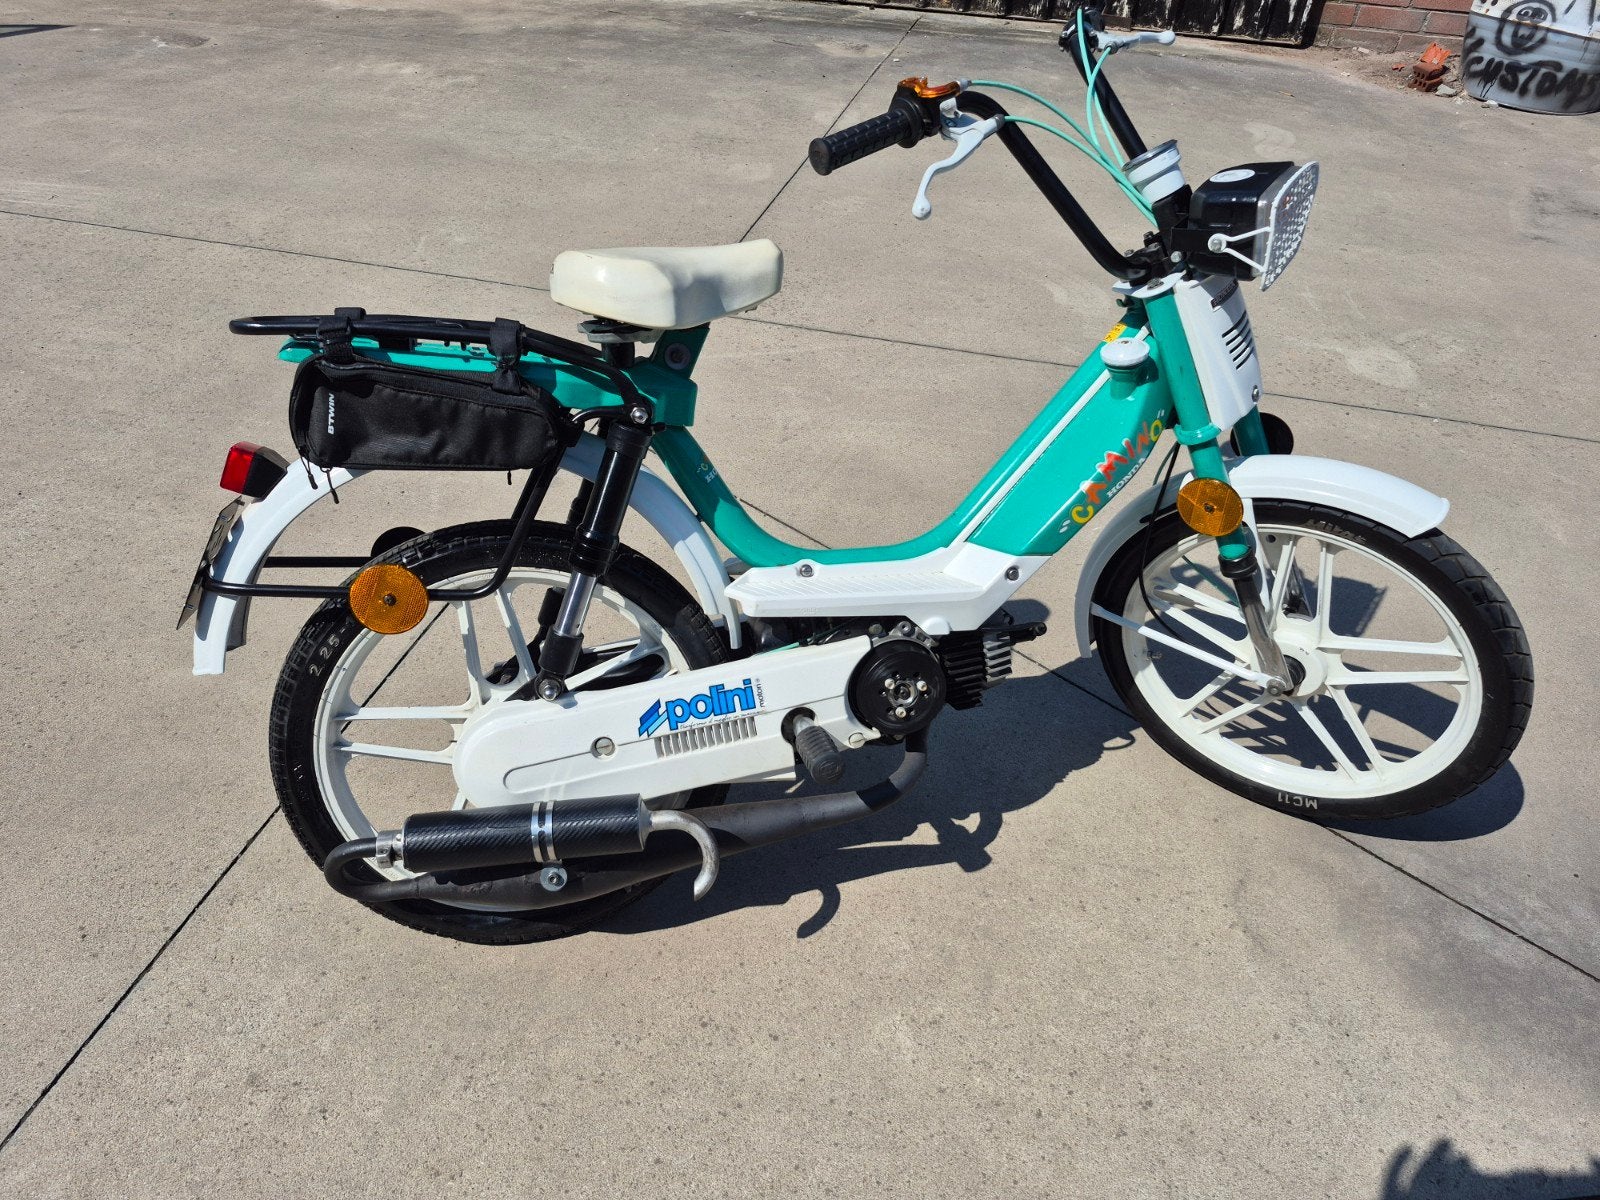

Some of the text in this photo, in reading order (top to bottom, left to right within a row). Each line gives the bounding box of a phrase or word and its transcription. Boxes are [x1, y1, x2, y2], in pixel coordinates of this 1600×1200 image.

[1106, 457, 1147, 498] HONDA
[665, 678, 757, 731] polini
[1277, 791, 1318, 810] MC11
